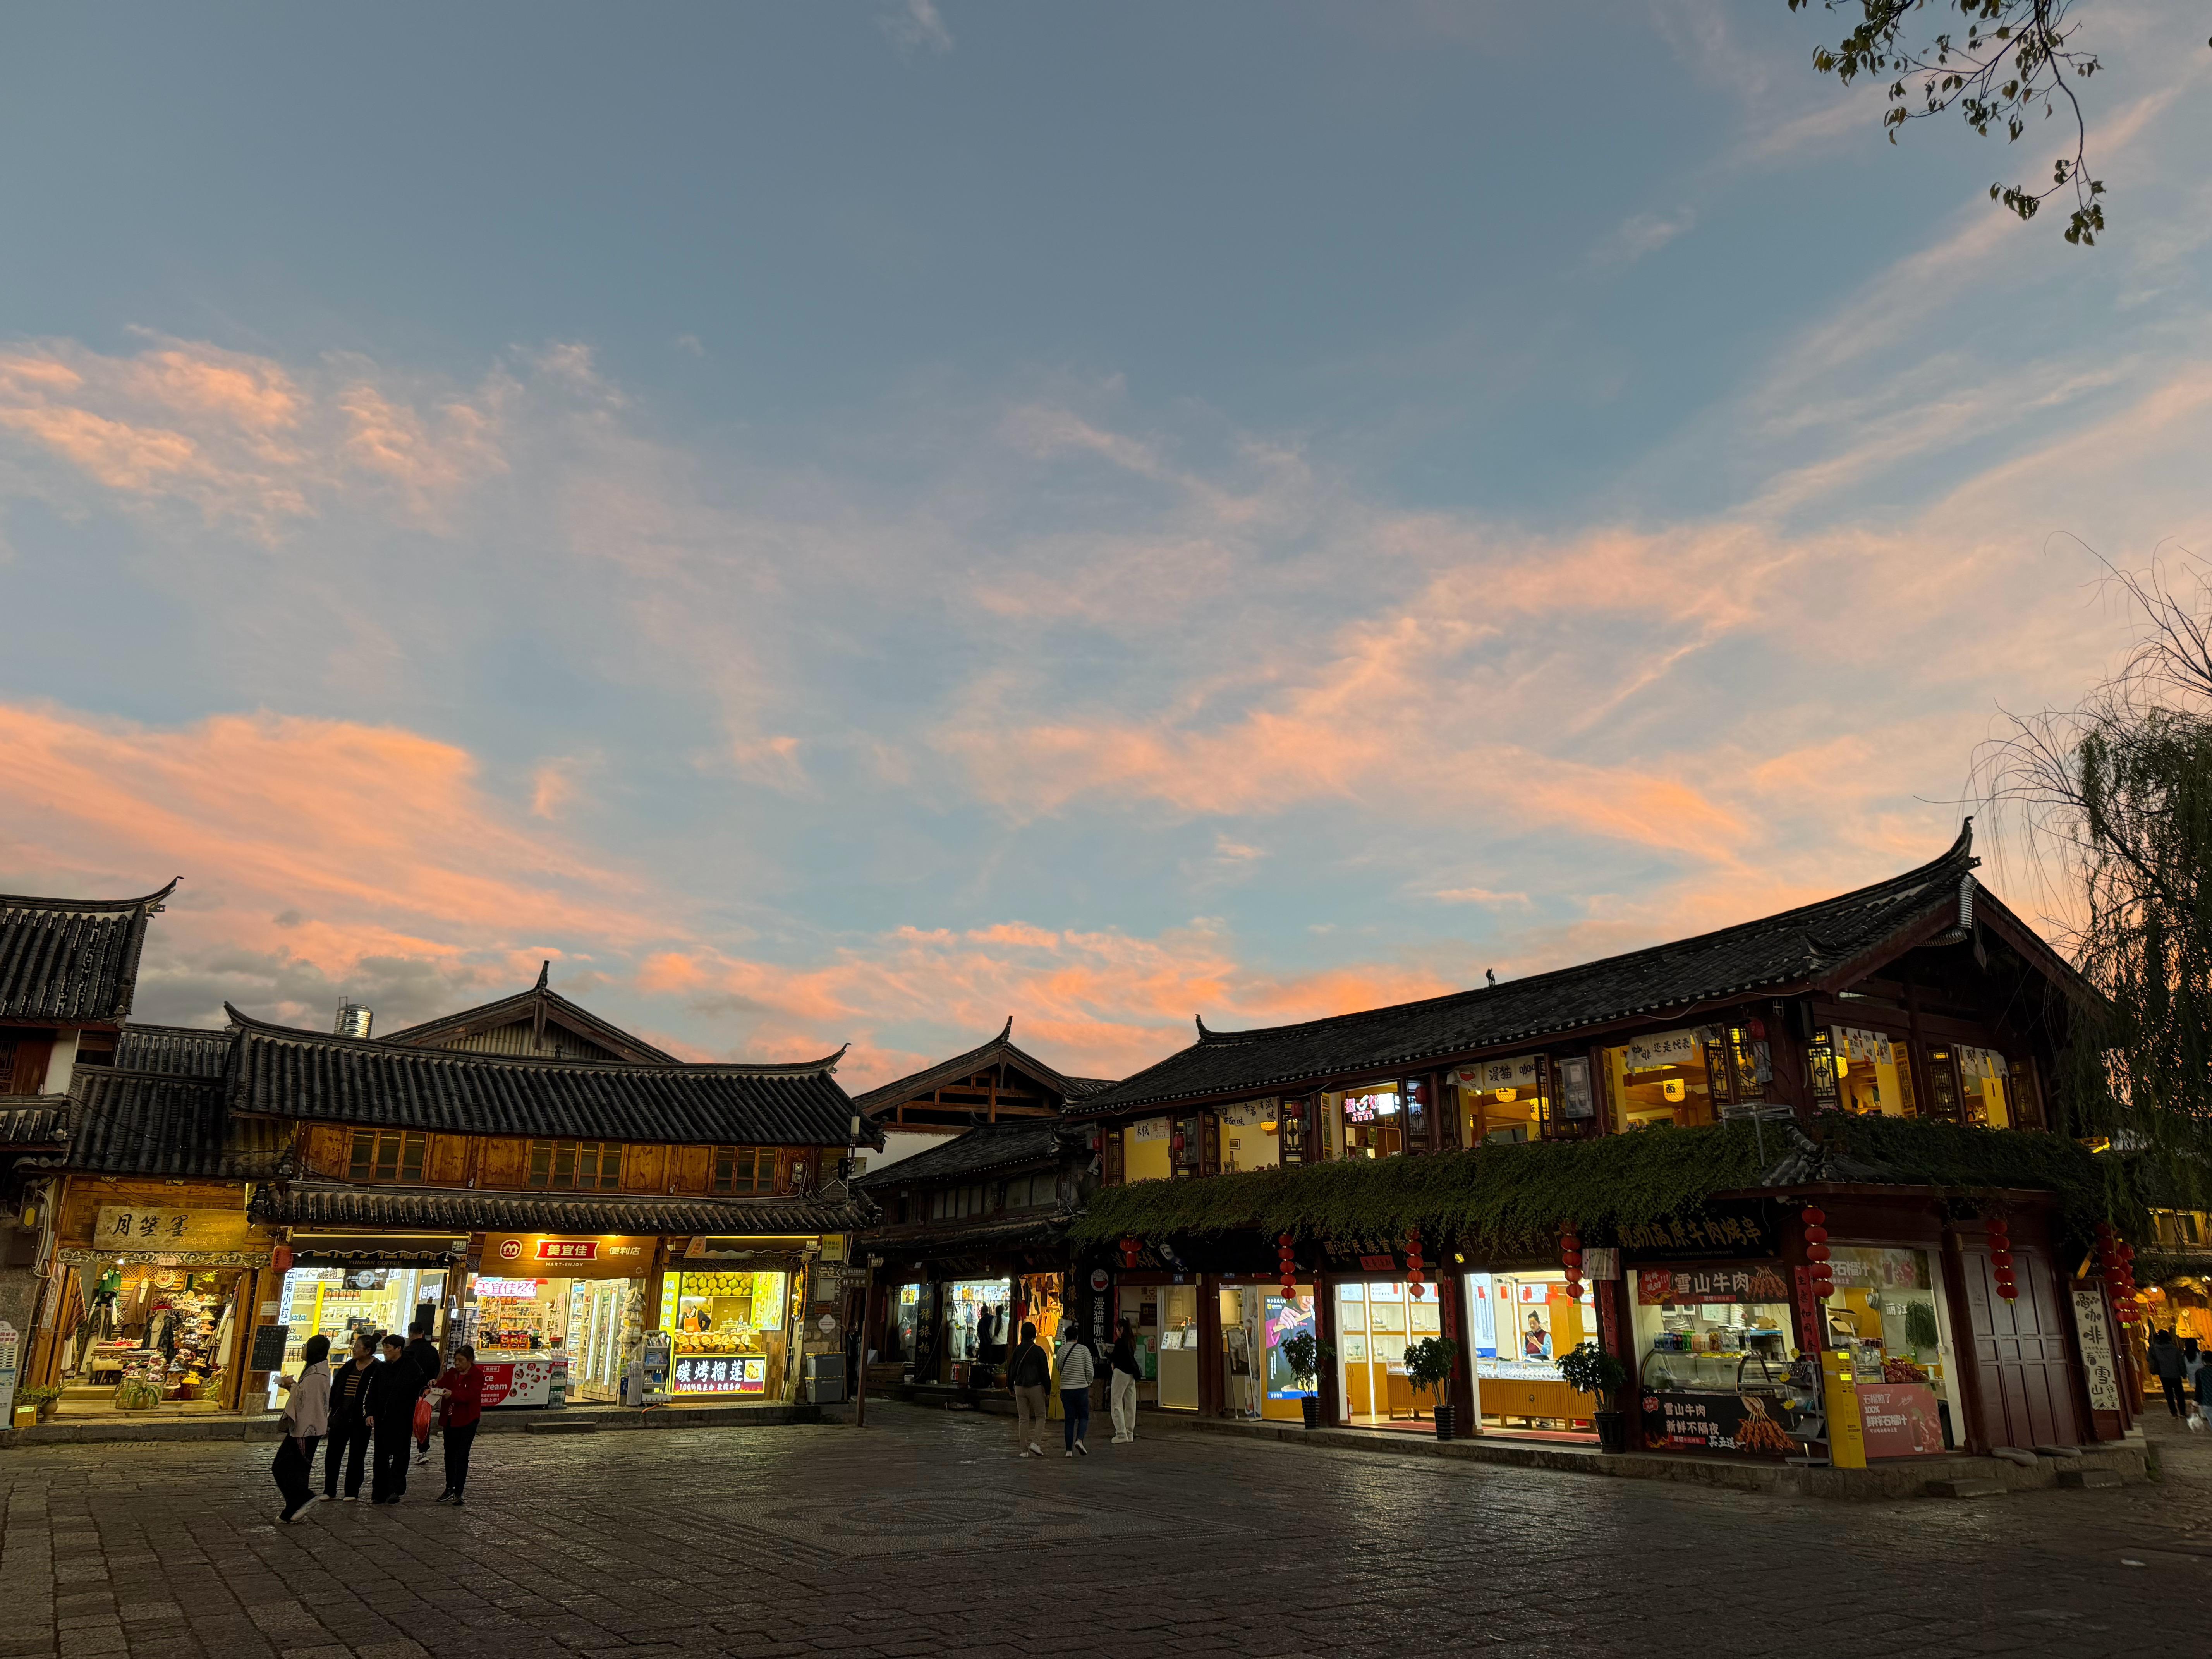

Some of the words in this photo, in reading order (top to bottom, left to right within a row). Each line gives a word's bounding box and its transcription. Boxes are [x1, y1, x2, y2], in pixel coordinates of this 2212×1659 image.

[547, 1244, 587, 1256] 美宜佳
[609, 1247, 641, 1255] 便利店
[1674, 1271, 1749, 1294] 雪山牛肉
[1885, 1303, 1908, 1316] 丽江
[676, 1359, 743, 1382] 碳烤榴莲
[1664, 1402, 1706, 1417] 雪山牛肉
[1864, 1406, 1881, 1414] 100%
[1666, 1419, 1720, 1436] 新鲜不隔夜
[1866, 1414, 1908, 1427] 鲜榨石榴汁
